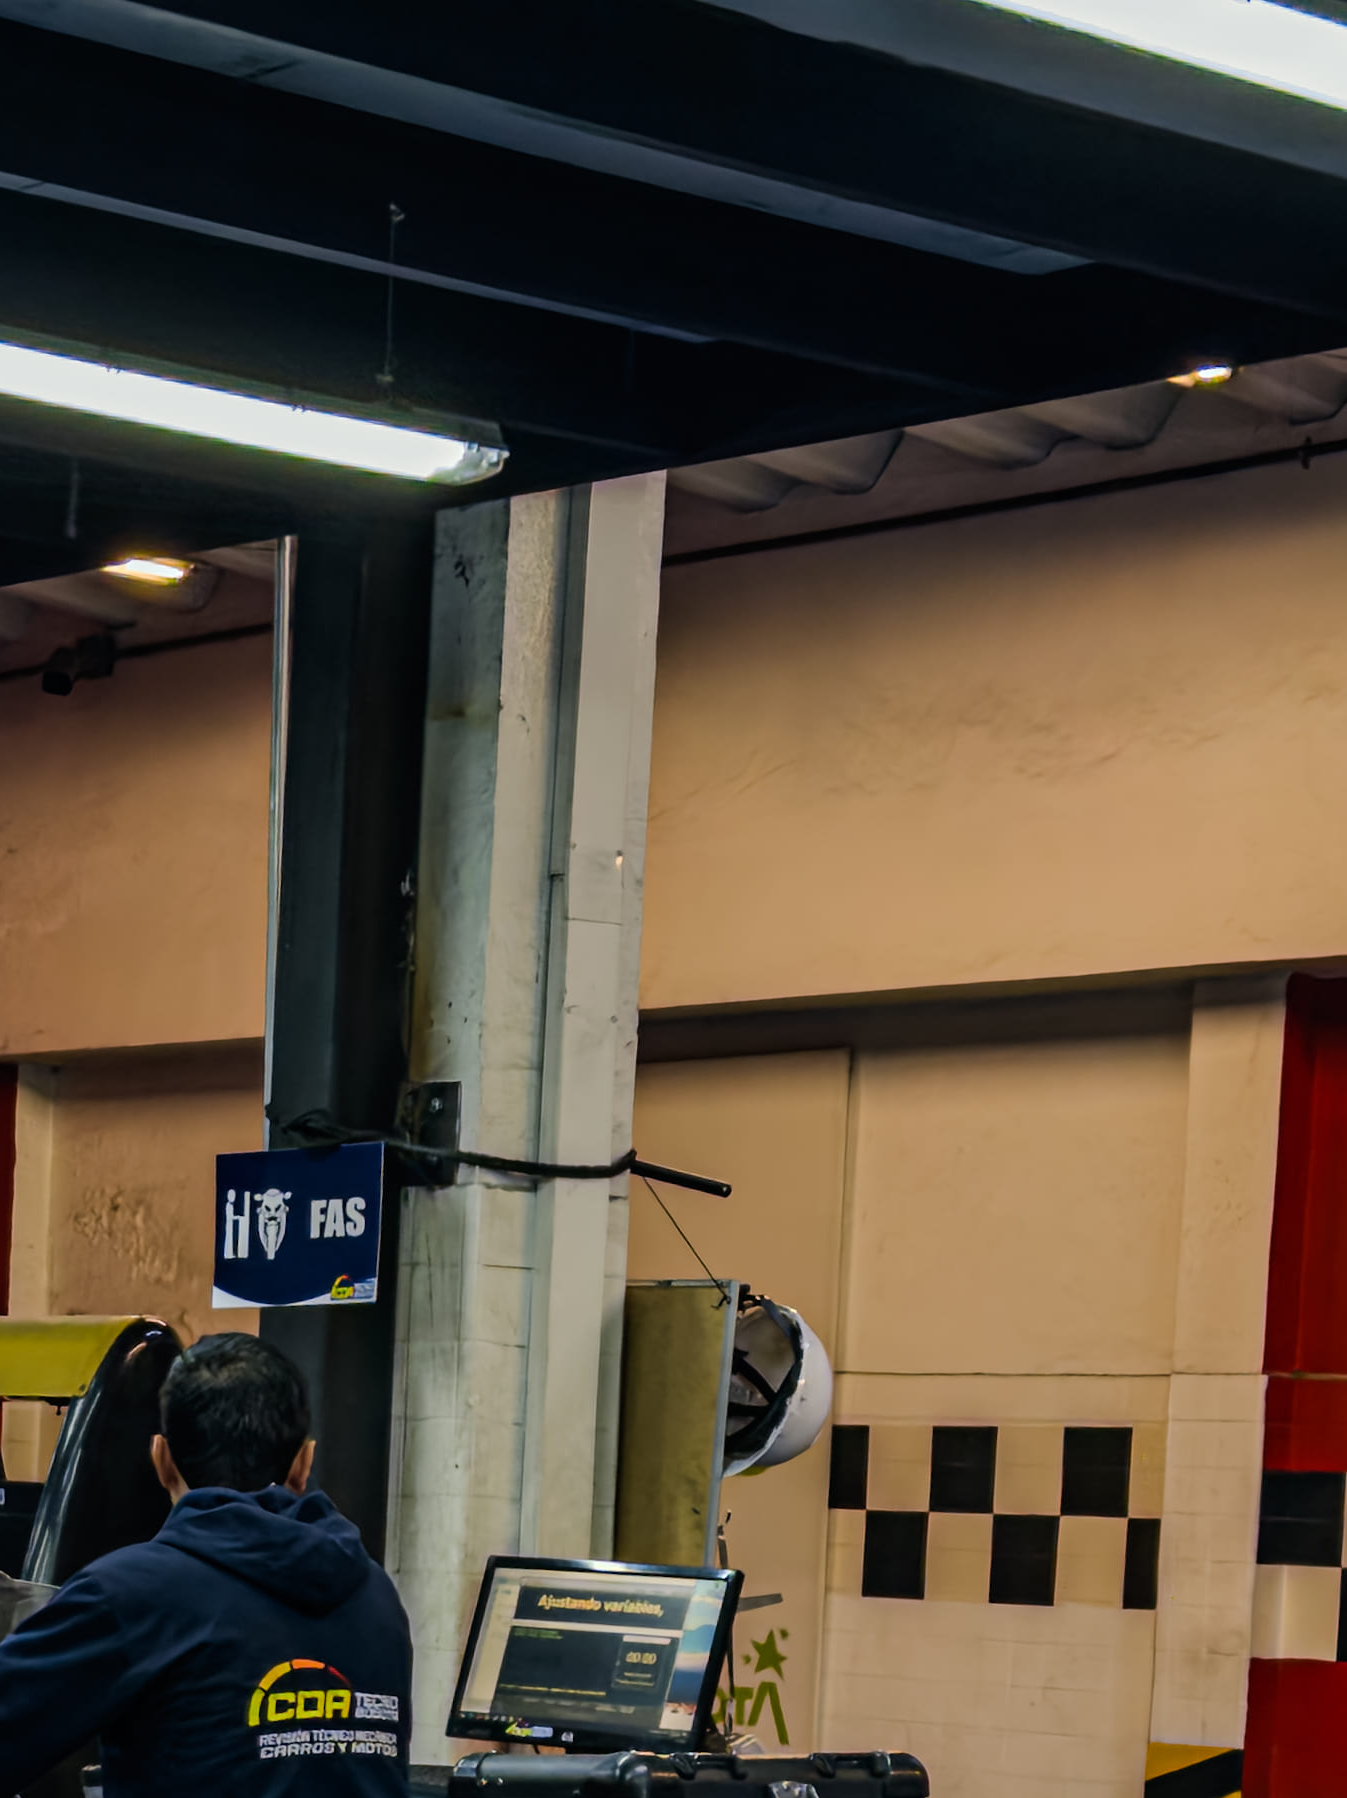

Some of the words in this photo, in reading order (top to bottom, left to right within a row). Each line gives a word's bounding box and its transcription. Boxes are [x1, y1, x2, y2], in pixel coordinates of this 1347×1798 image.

[309, 1196, 367, 1240] FAS
[537, 1594, 602, 1611] Ajustando
[266, 1689, 352, 1722] CDA
[259, 1742, 335, 1760] CARROS
[337, 1741, 348, 1754] Y
[351, 1742, 398, 1758] MOTOS
